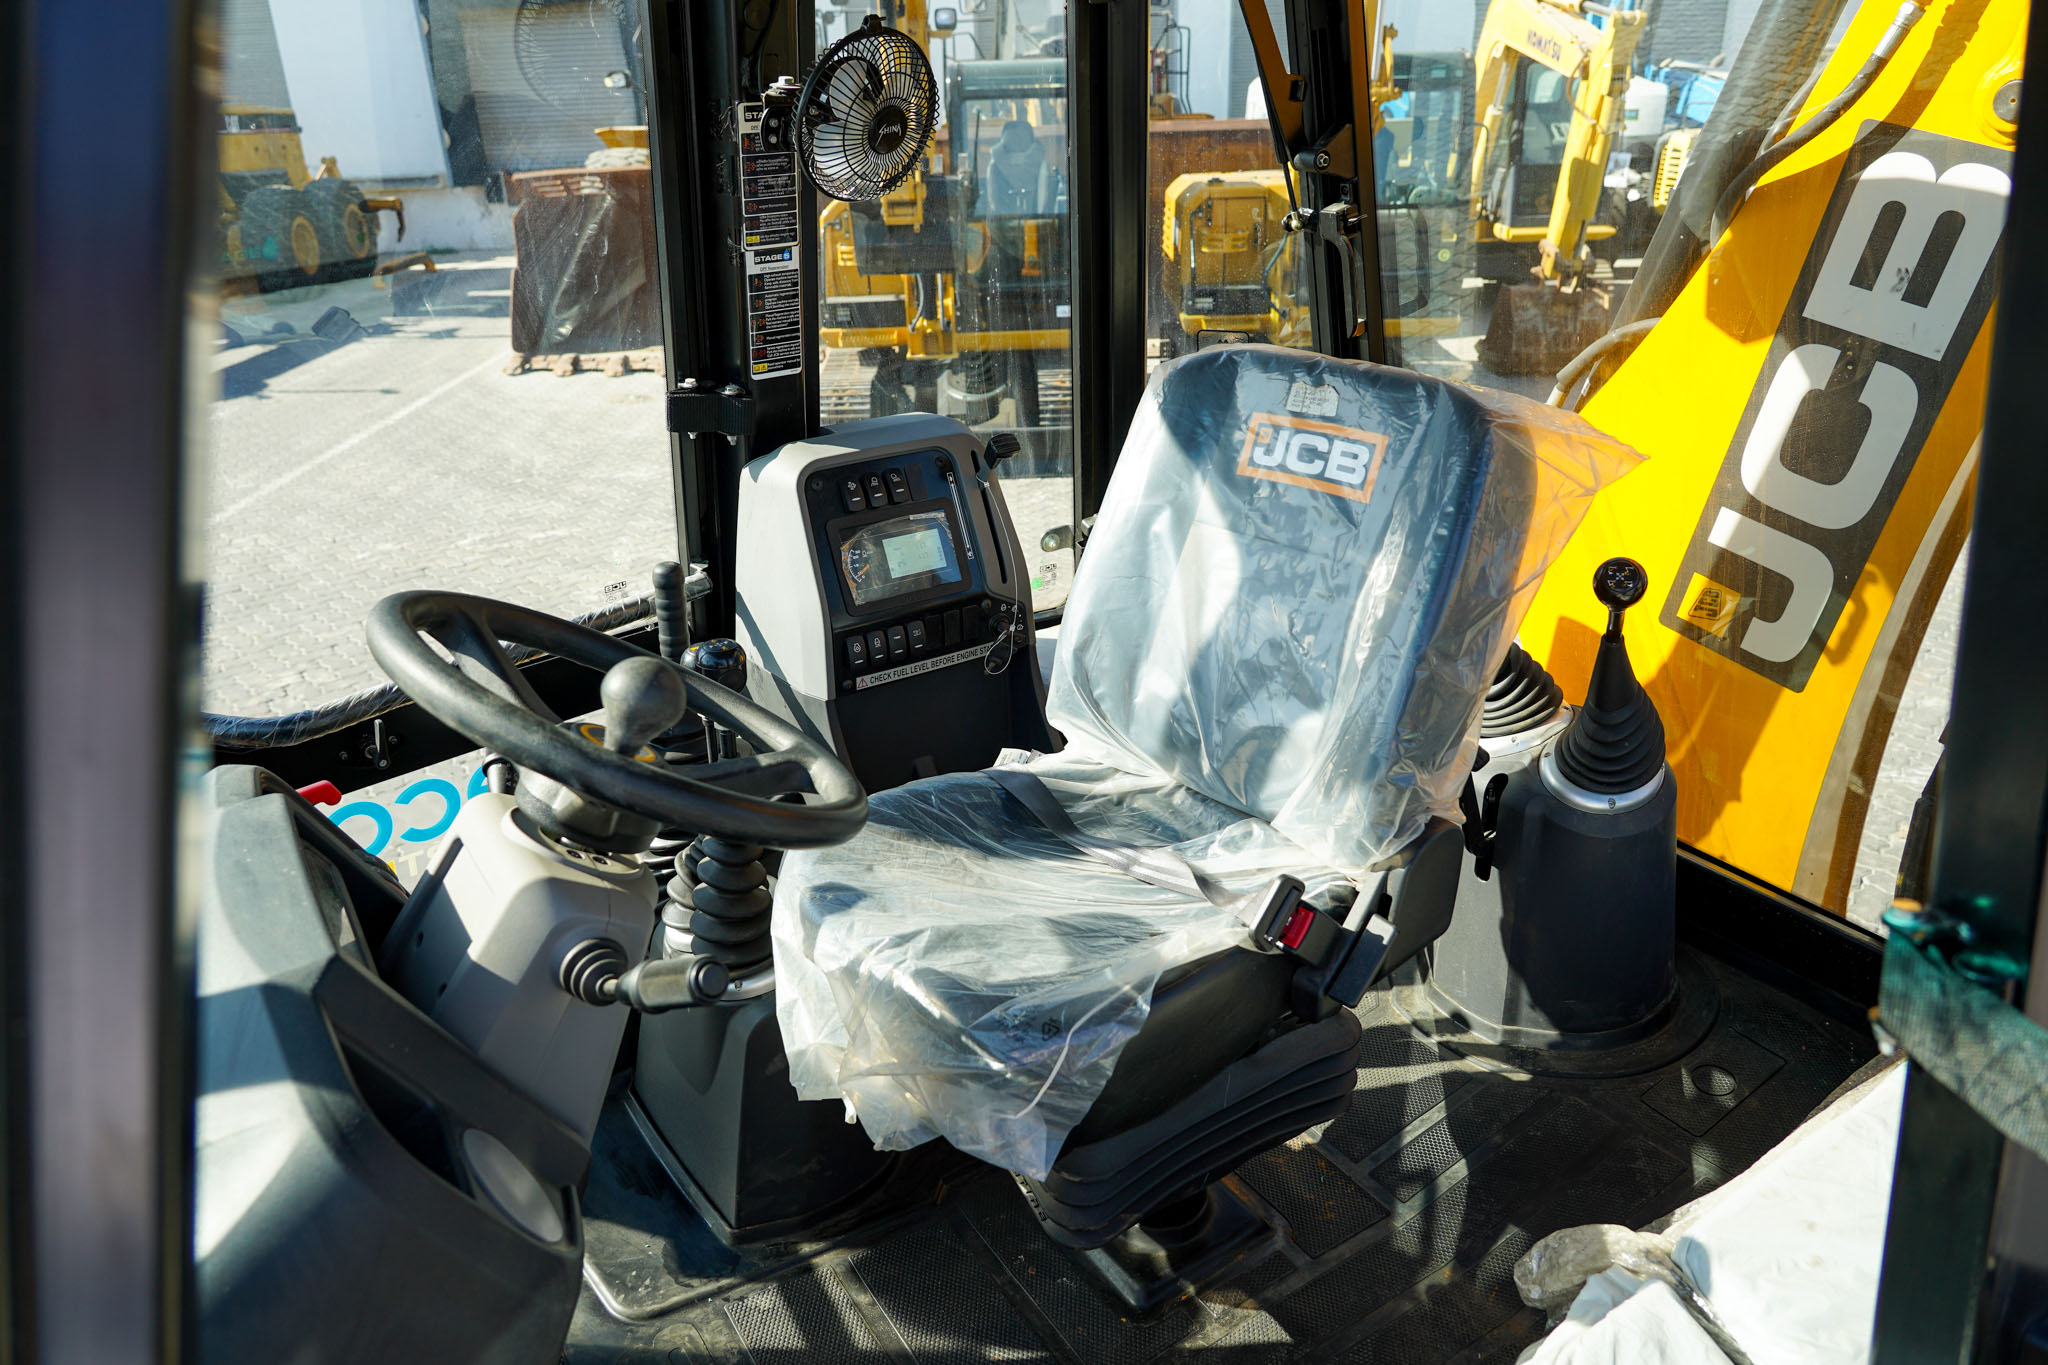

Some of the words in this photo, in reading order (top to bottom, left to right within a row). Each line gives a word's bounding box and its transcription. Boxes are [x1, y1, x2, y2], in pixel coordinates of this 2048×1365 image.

[744, 111, 763, 119] STA
[754, 253, 783, 263] STAGE
[1707, 151, 2012, 663] JCB
[1253, 430, 1370, 485] JCB
[869, 672, 892, 684] CHECK
[893, 669, 909, 680] FUEL
[910, 663, 930, 674] LEVEL
[931, 657, 956, 669] BEFORE
[956, 651, 979, 662] ENGINE
[979, 645, 992, 655] STA
